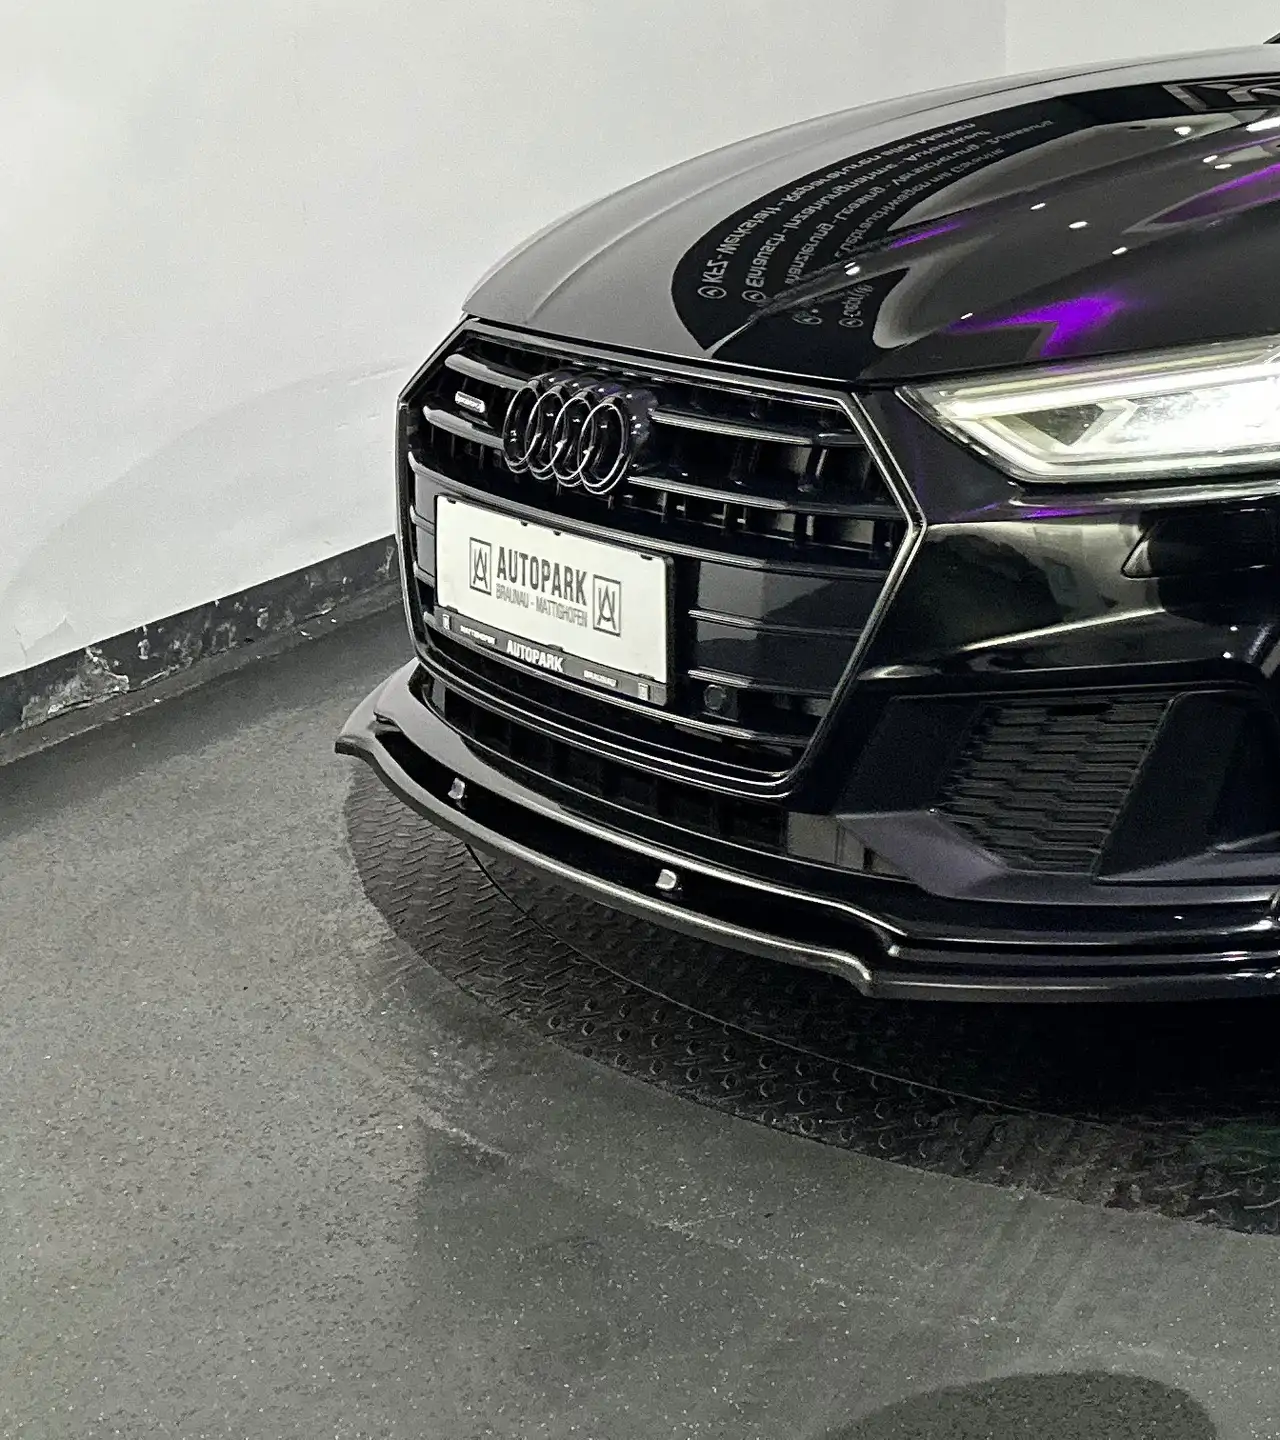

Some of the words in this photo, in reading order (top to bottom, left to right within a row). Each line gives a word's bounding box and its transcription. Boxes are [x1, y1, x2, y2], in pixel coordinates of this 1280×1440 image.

[496, 546, 588, 606] AUTOPARK
[495, 583, 530, 609] BRAUNAU
[506, 639, 564, 673] AUTOPARK
